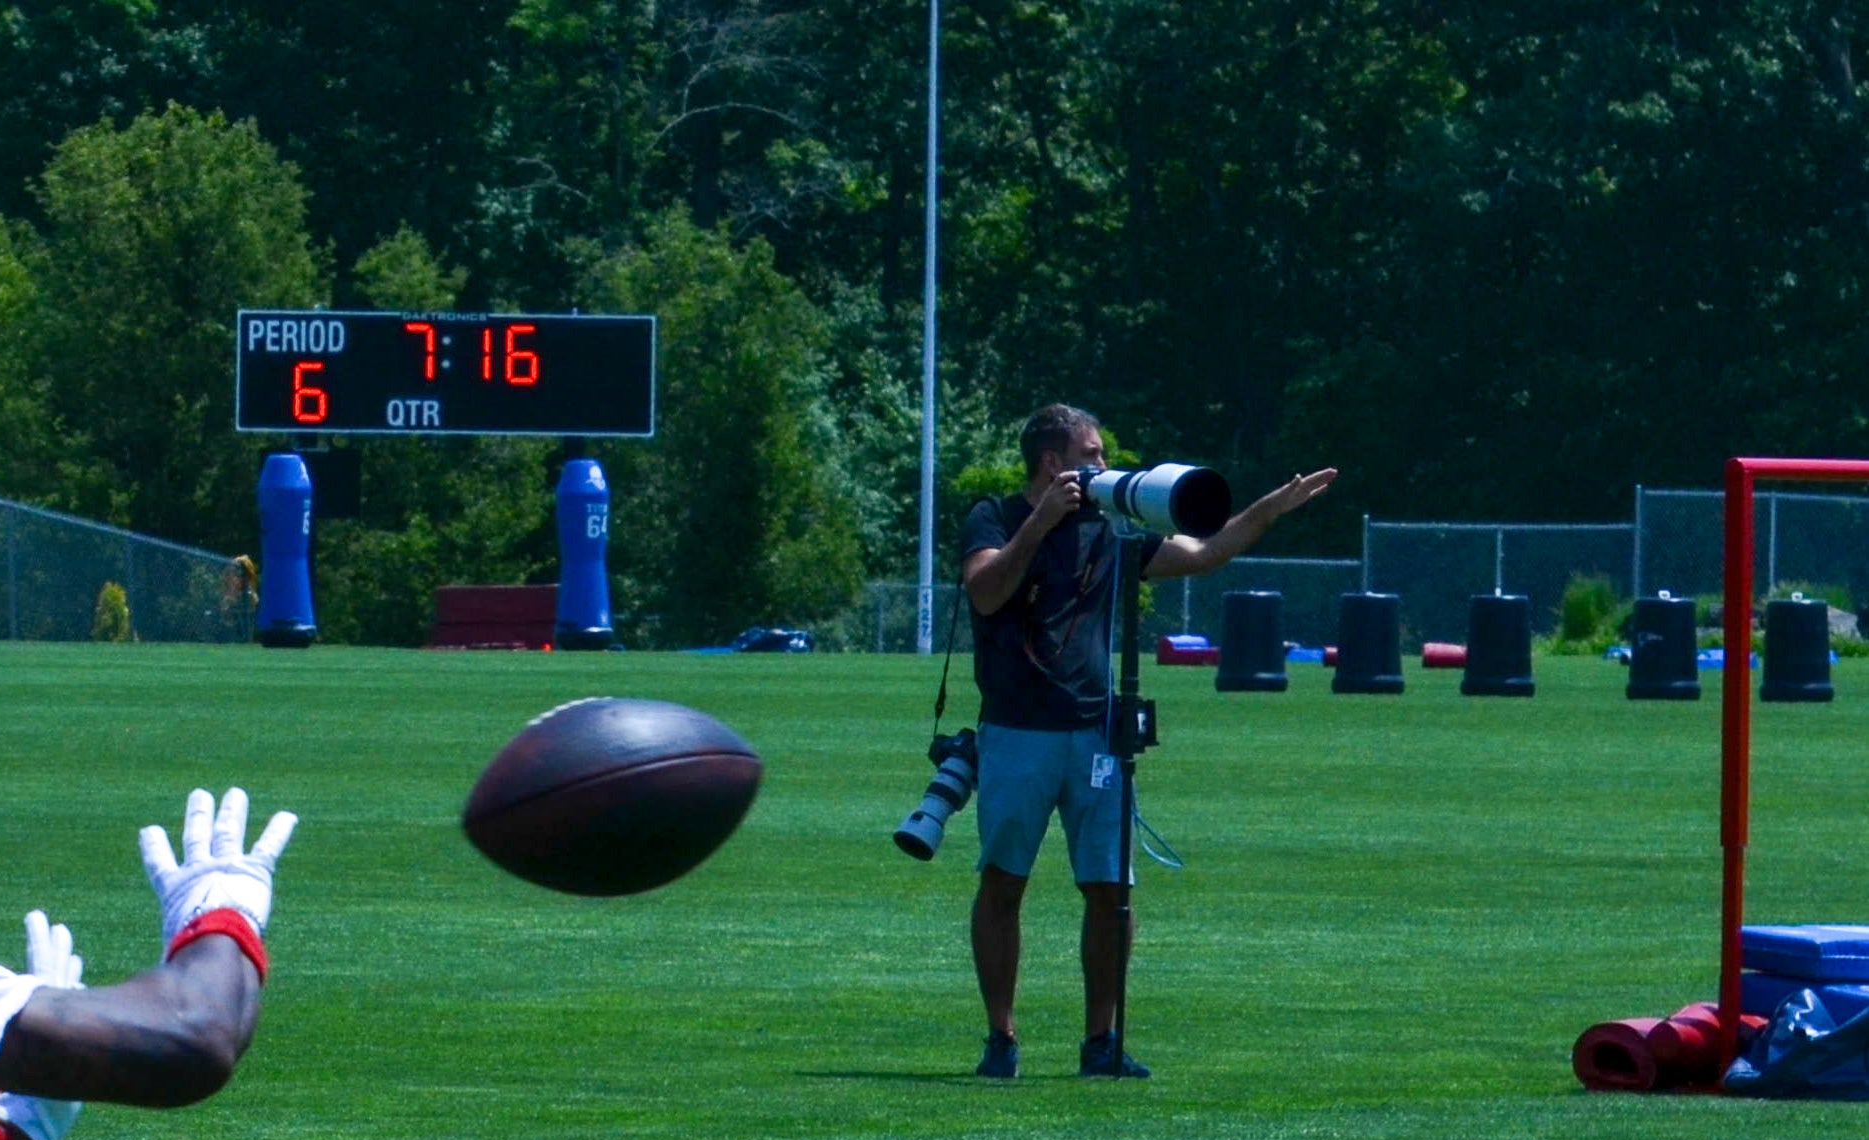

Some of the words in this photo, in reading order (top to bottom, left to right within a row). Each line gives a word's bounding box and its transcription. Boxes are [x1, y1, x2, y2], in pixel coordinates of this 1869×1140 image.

[248, 320, 345, 352] PERIOD
[293, 360, 328, 422] 6
[387, 400, 440, 427] QTR
